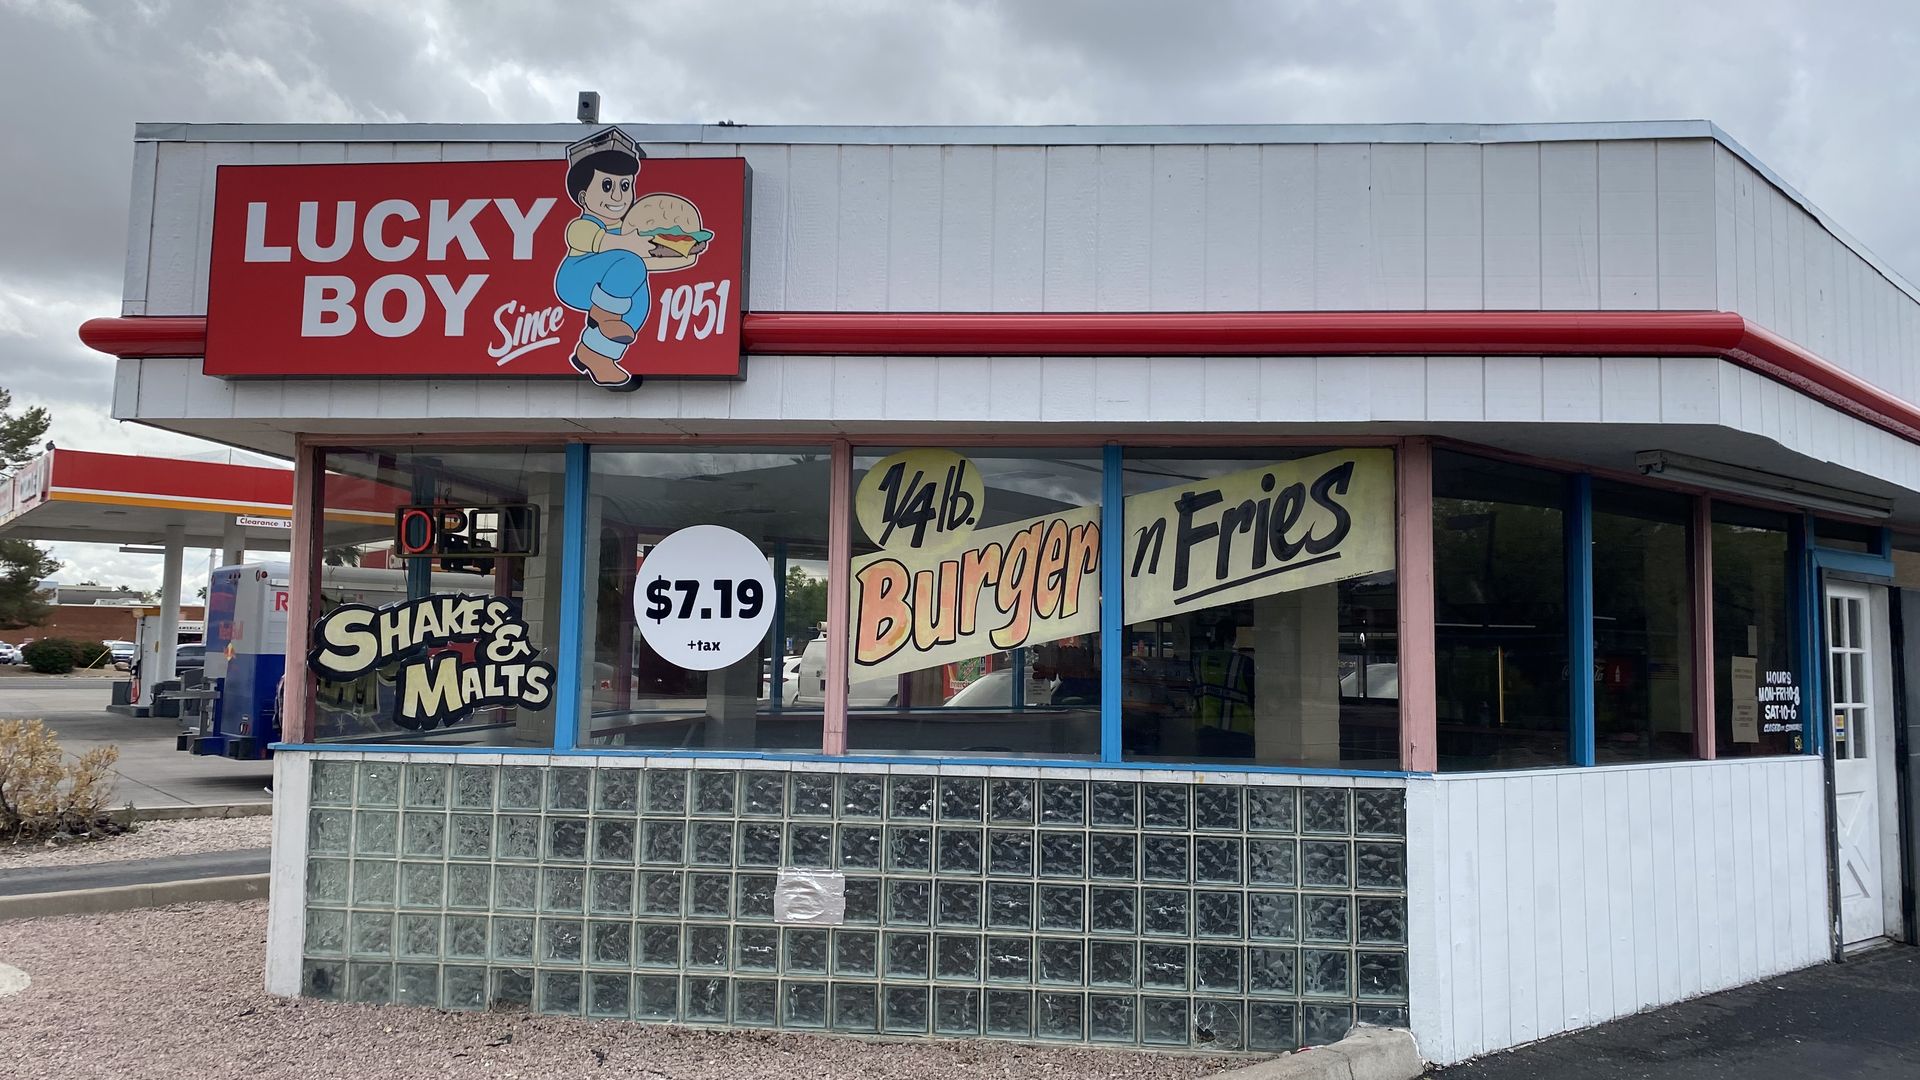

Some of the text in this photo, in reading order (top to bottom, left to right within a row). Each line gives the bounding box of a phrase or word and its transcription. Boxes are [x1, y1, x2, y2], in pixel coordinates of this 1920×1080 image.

[244, 198, 558, 262] LUCKY
[301, 274, 490, 337] BOY
[487, 279, 730, 358] Since 1951
[239, 517, 279, 527] Clearance
[401, 509, 535, 553] OPEN
[854, 461, 1355, 666] Burger n Fries
[646, 575, 764, 625] $7.19
[318, 598, 532, 673] SHAKES &
[687, 640, 721, 652] +tax
[402, 657, 550, 719] MALTS
[1765, 671, 1792, 685] HOURS
